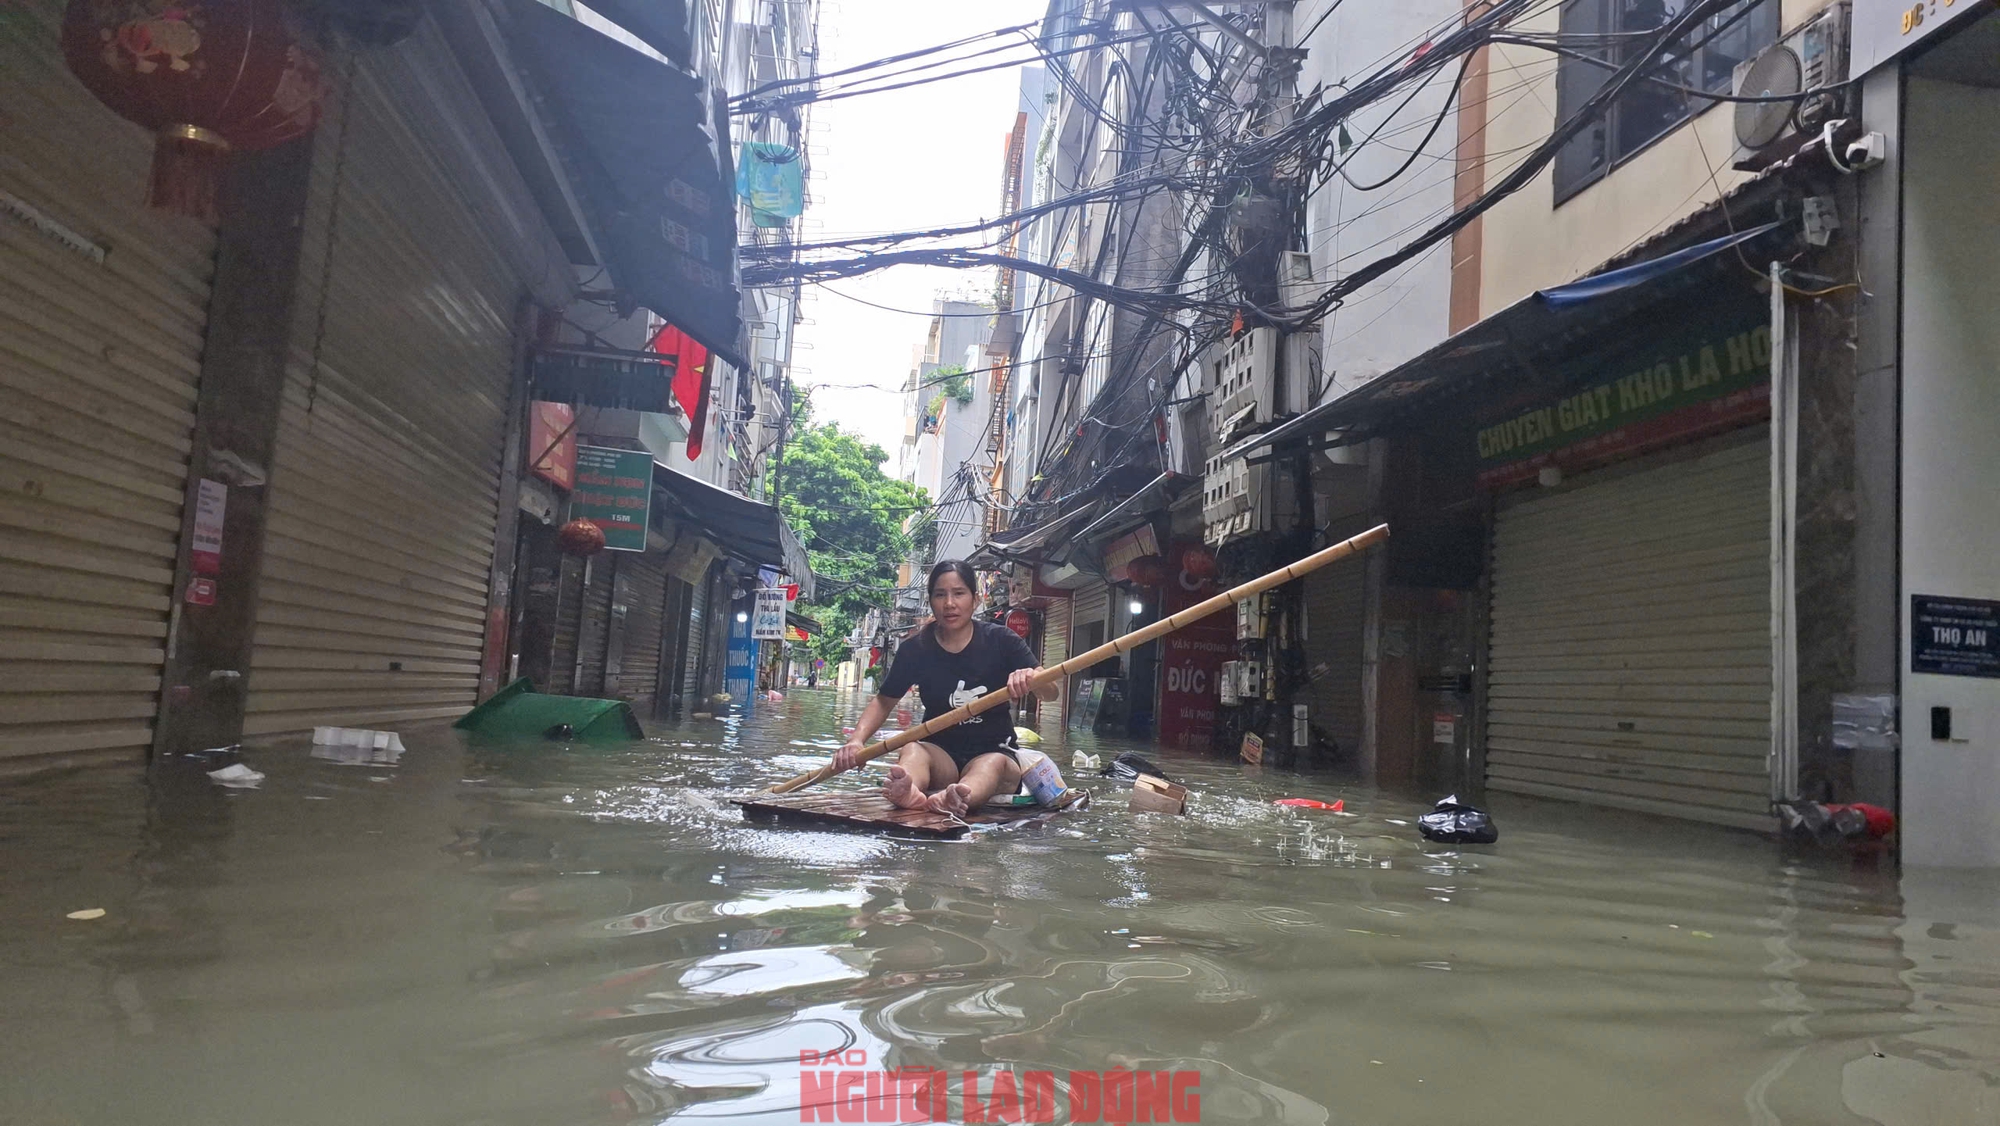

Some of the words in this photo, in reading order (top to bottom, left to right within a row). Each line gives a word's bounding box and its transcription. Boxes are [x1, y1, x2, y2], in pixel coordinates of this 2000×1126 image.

[1477, 407, 1554, 459] CHUYÊN
[1931, 626, 1961, 648] THỌ
[1965, 629, 1987, 647] AN
[728, 643, 749, 667] THUỐC
[1168, 658, 1206, 694] ĐỨC
